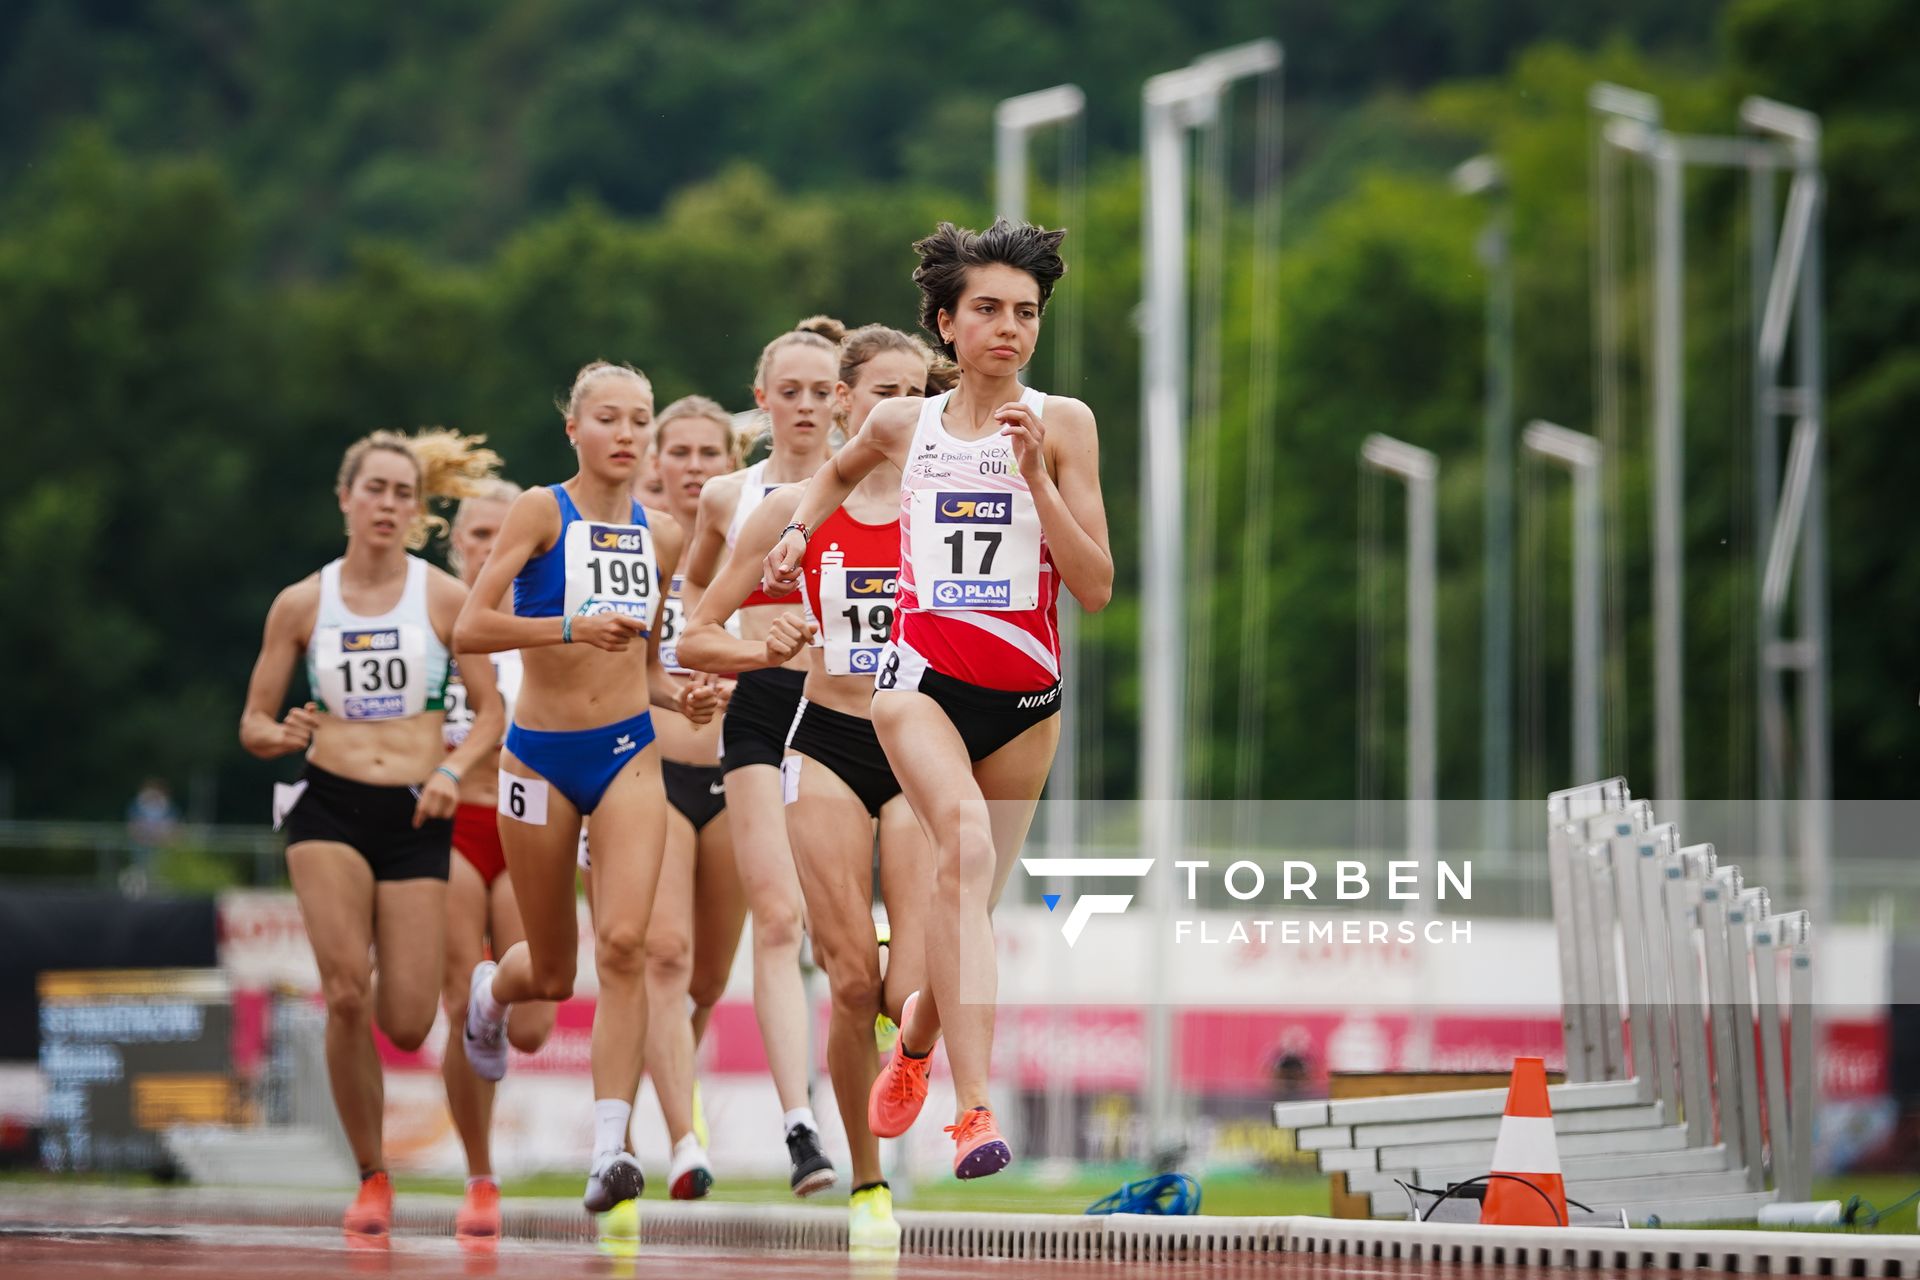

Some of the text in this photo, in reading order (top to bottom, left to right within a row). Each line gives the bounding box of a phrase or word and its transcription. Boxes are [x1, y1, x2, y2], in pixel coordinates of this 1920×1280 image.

[941, 452, 973, 463] Epsilon
[975, 501, 1006, 519] GLS
[617, 534, 641, 551] GLS
[944, 530, 1002, 575] 17
[587, 557, 650, 597] 199
[965, 584, 1008, 598] PLAN
[842, 604, 895, 643] 19
[336, 657, 407, 693] 130
[879, 650, 900, 689] 8
[1016, 688, 1057, 709] NIKE
[510, 782, 525, 818] 6
